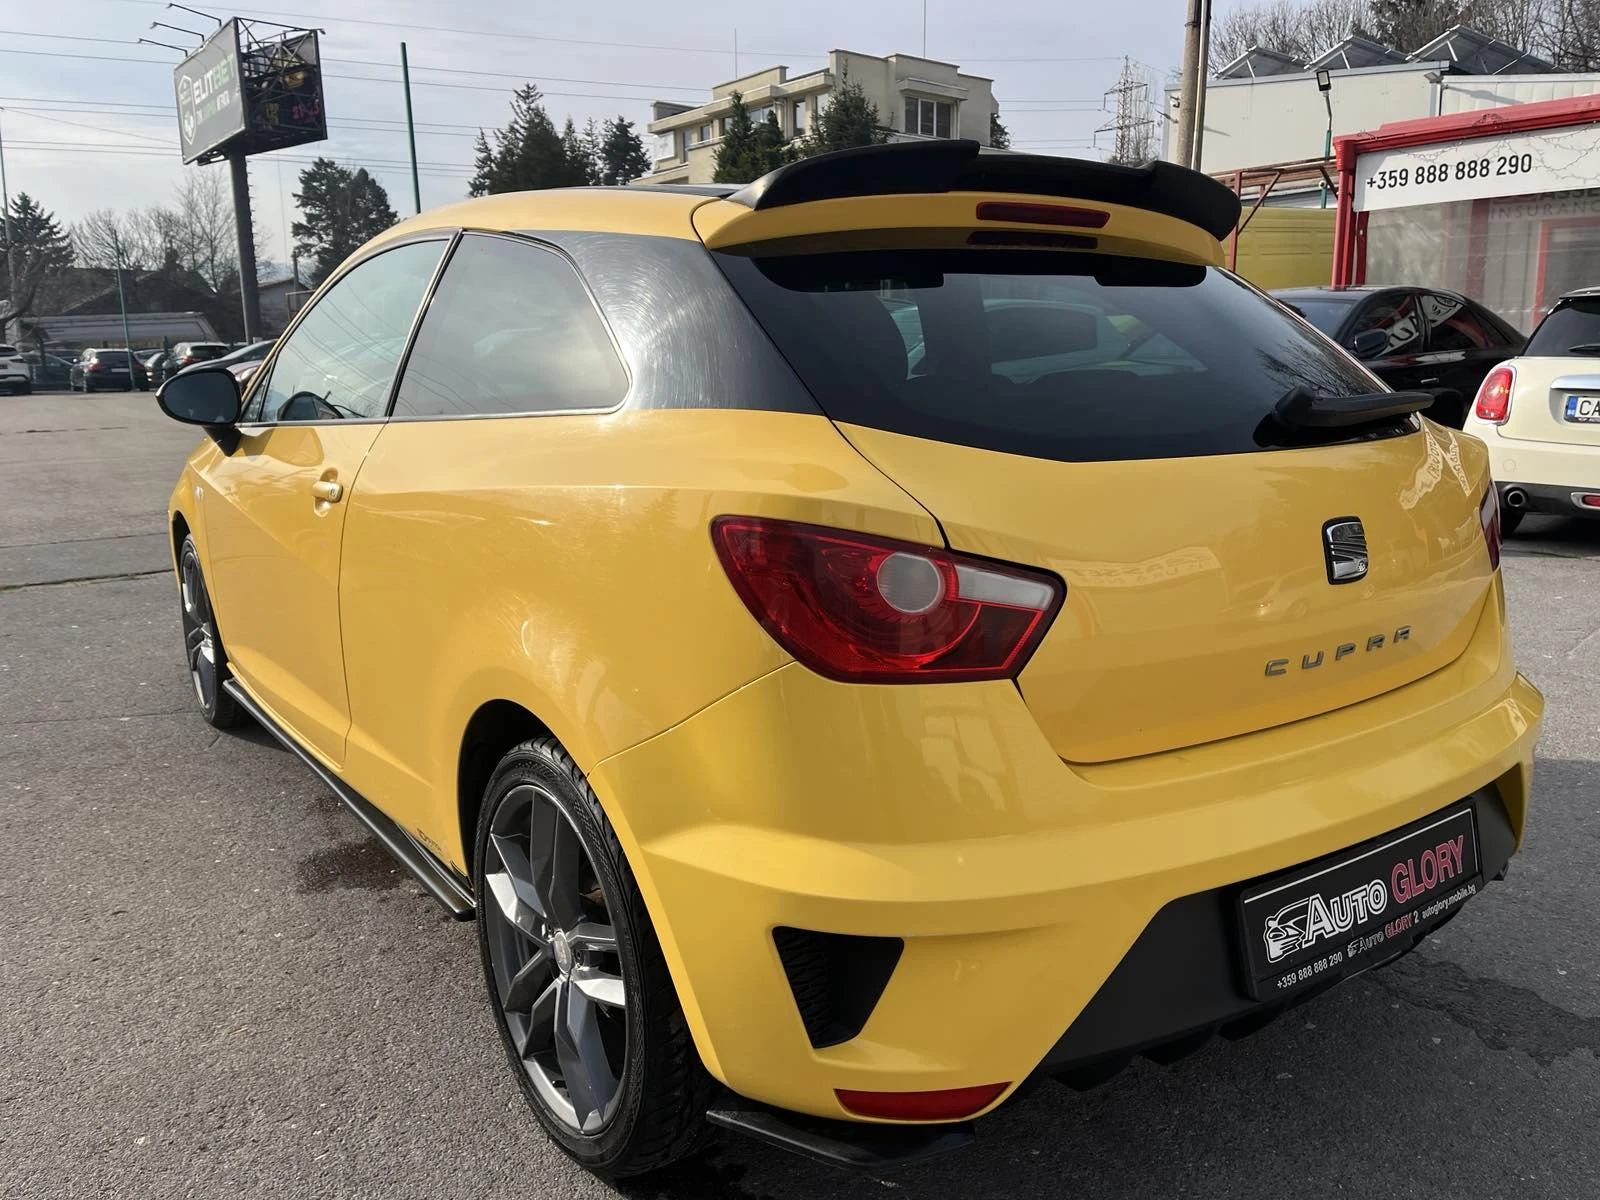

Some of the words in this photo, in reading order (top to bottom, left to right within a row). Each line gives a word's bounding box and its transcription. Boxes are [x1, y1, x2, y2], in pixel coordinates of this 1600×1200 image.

[1367, 168, 1408, 189] +359
[1415, 163, 1448, 185] 888
[1455, 158, 1490, 180] 888
[1496, 153, 1532, 176] 290
[1265, 625, 1411, 677] CUPRA
[1391, 835, 1464, 903] GLORY
[1277, 972, 1297, 989] +359
[1298, 965, 1313, 981] 888
[1313, 958, 1328, 973] 888
[1329, 951, 1343, 967] 290
[1385, 912, 1412, 938] GLORY
[1413, 910, 1419, 924] 2
[1422, 884, 1476, 919] autoglory.mobile.bg
